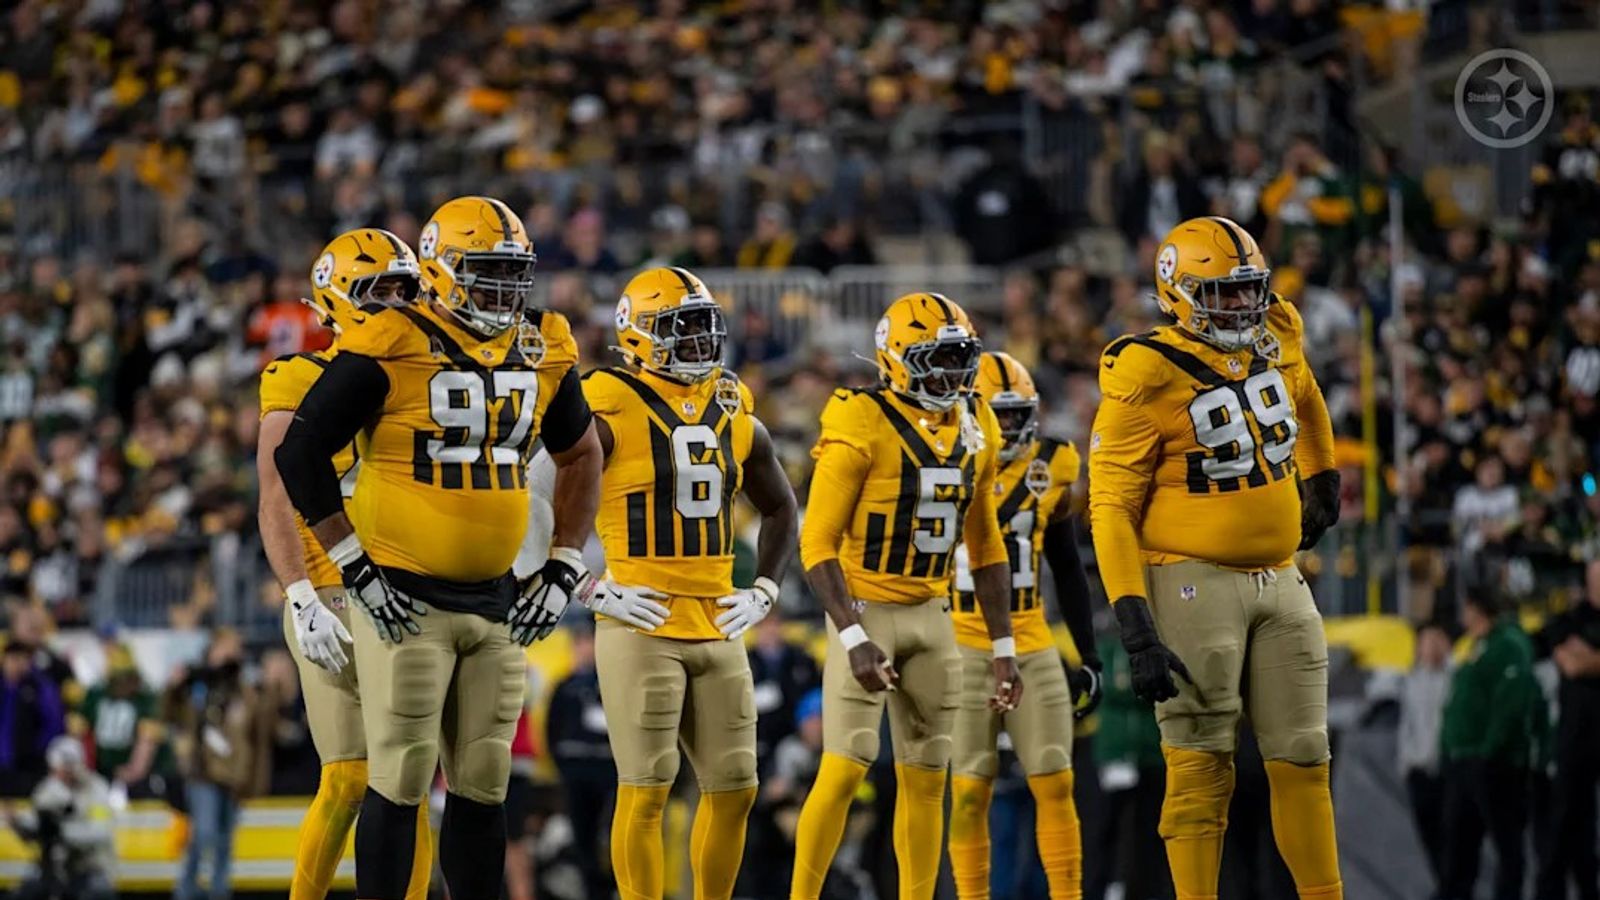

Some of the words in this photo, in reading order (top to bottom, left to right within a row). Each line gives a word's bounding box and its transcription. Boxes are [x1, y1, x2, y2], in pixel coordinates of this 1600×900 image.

[427, 371, 538, 464] 97
[1189, 367, 1298, 480] 99
[671, 424, 723, 518] 6
[914, 467, 963, 553] 5
